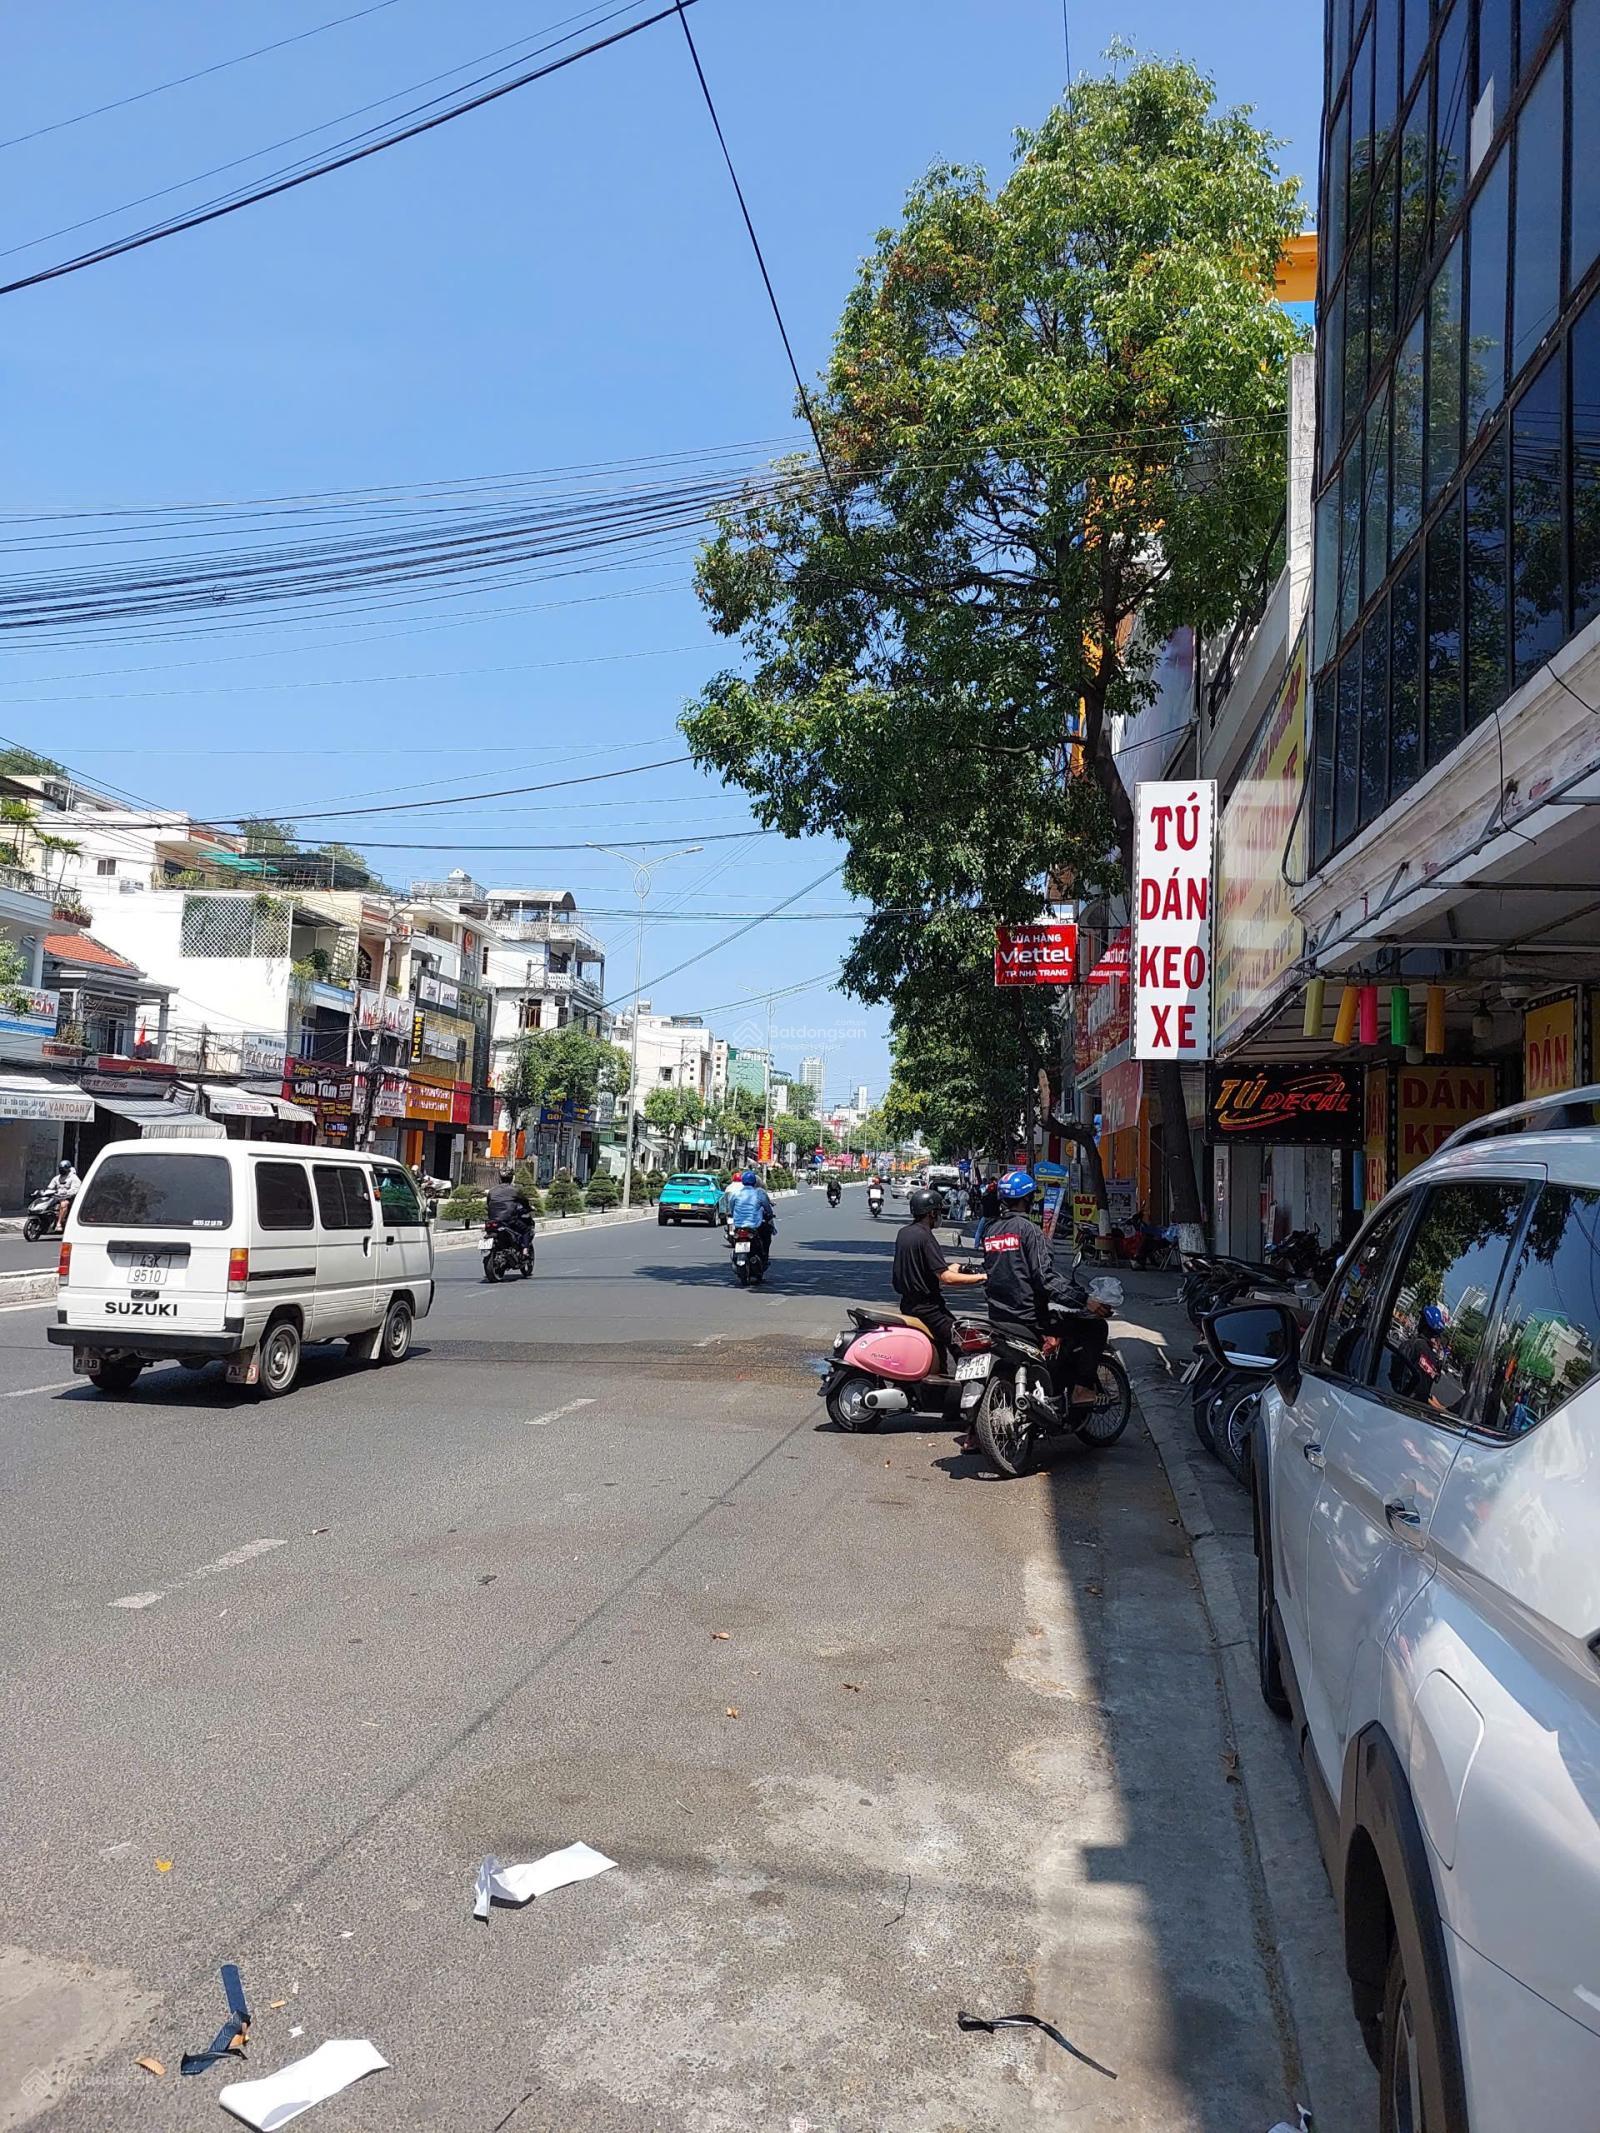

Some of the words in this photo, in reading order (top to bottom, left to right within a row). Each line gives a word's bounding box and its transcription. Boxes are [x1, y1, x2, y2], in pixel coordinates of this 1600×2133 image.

[1150, 791, 1200, 851] TÚ
[1140, 866, 1207, 921] DÁN
[1000, 946, 1073, 964] viettel
[1011, 933, 1030, 944] CỬA
[1033, 932, 1062, 943] HÀNG
[1019, 969, 1037, 977] NHA
[1038, 968, 1068, 977] TRANG
[1139, 945, 1206, 990] KEO
[1150, 1004, 1197, 1049] XE
[1529, 1023, 1568, 1089] DÁN
[1214, 1072, 1267, 1110] TÚ
[1402, 1069, 1486, 1110] DÁN
[1404, 1122, 1442, 1155] KE
[133, 1268, 161, 1283] 9510
[139, 1254, 160, 1268] 43K
[105, 1301, 178, 1317] SUZUKI
